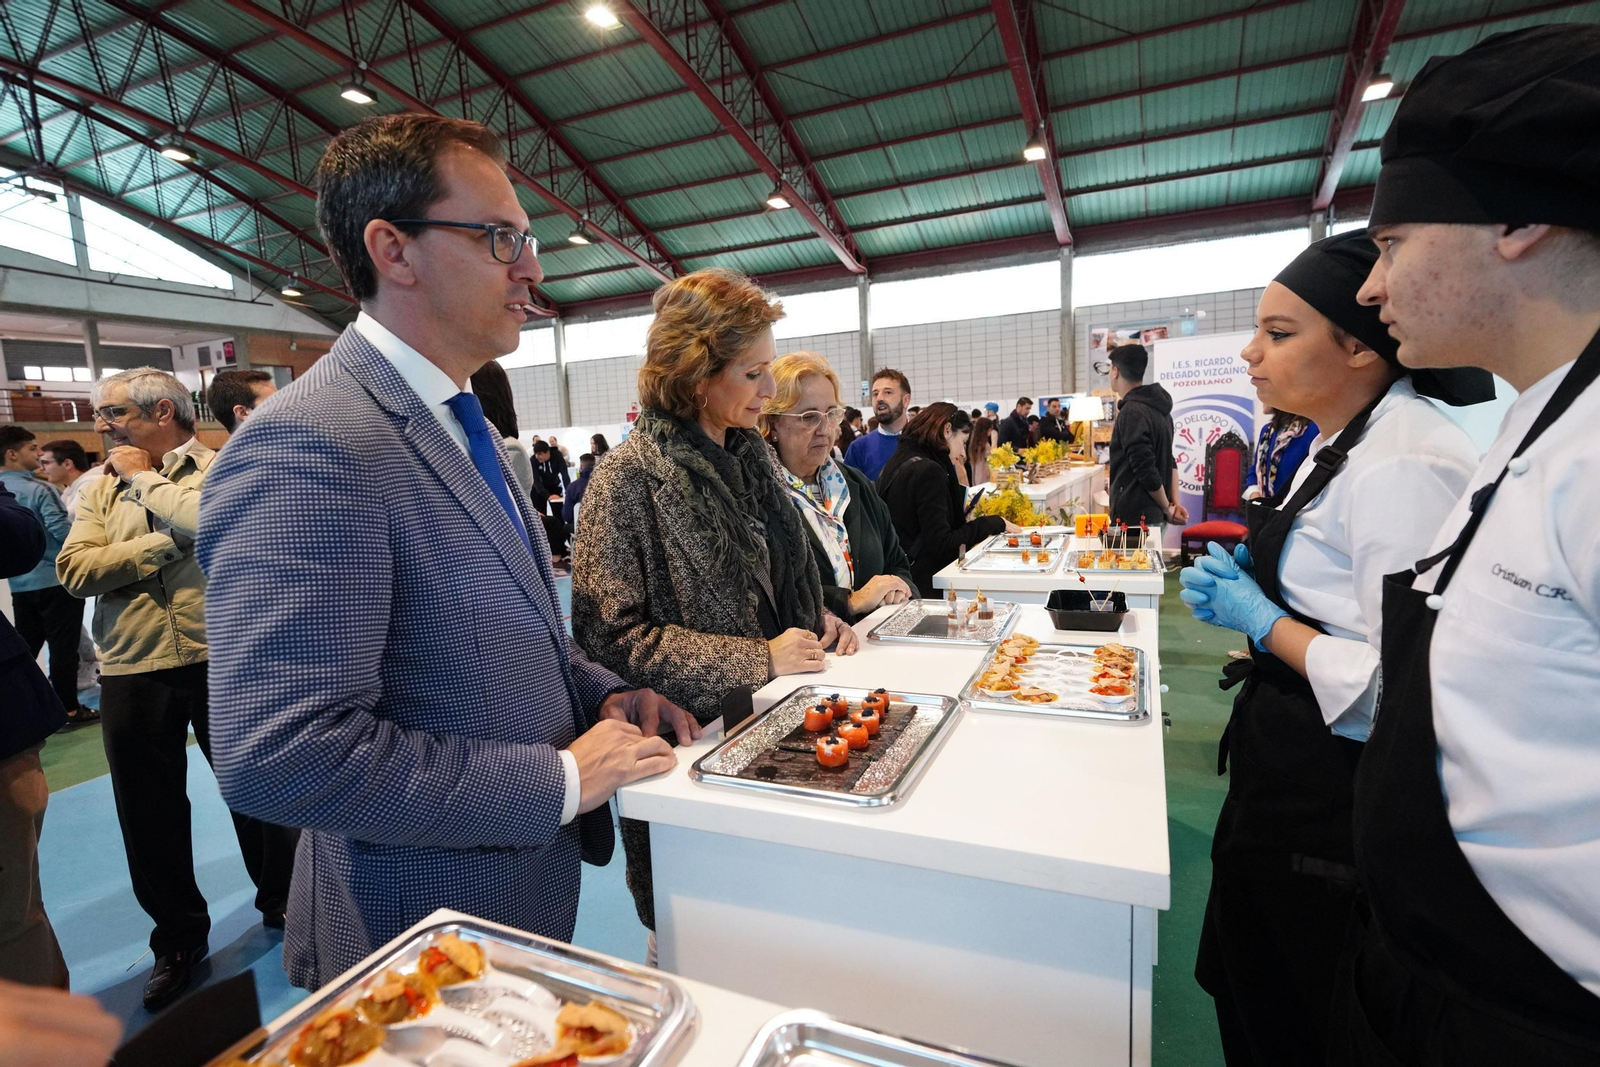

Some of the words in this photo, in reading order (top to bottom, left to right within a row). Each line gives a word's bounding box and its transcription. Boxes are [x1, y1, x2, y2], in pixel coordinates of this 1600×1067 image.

[1172, 360, 1192, 370] I.E.S.
[1195, 356, 1234, 367] RICARDO
[1160, 369, 1201, 380] DELGADO
[1203, 366, 1247, 377] VIZCAINO
[1173, 378, 1233, 387] POZOBLANCO
[1184, 413, 1229, 428] DELGADO
[1491, 563, 1532, 592] Cristian
